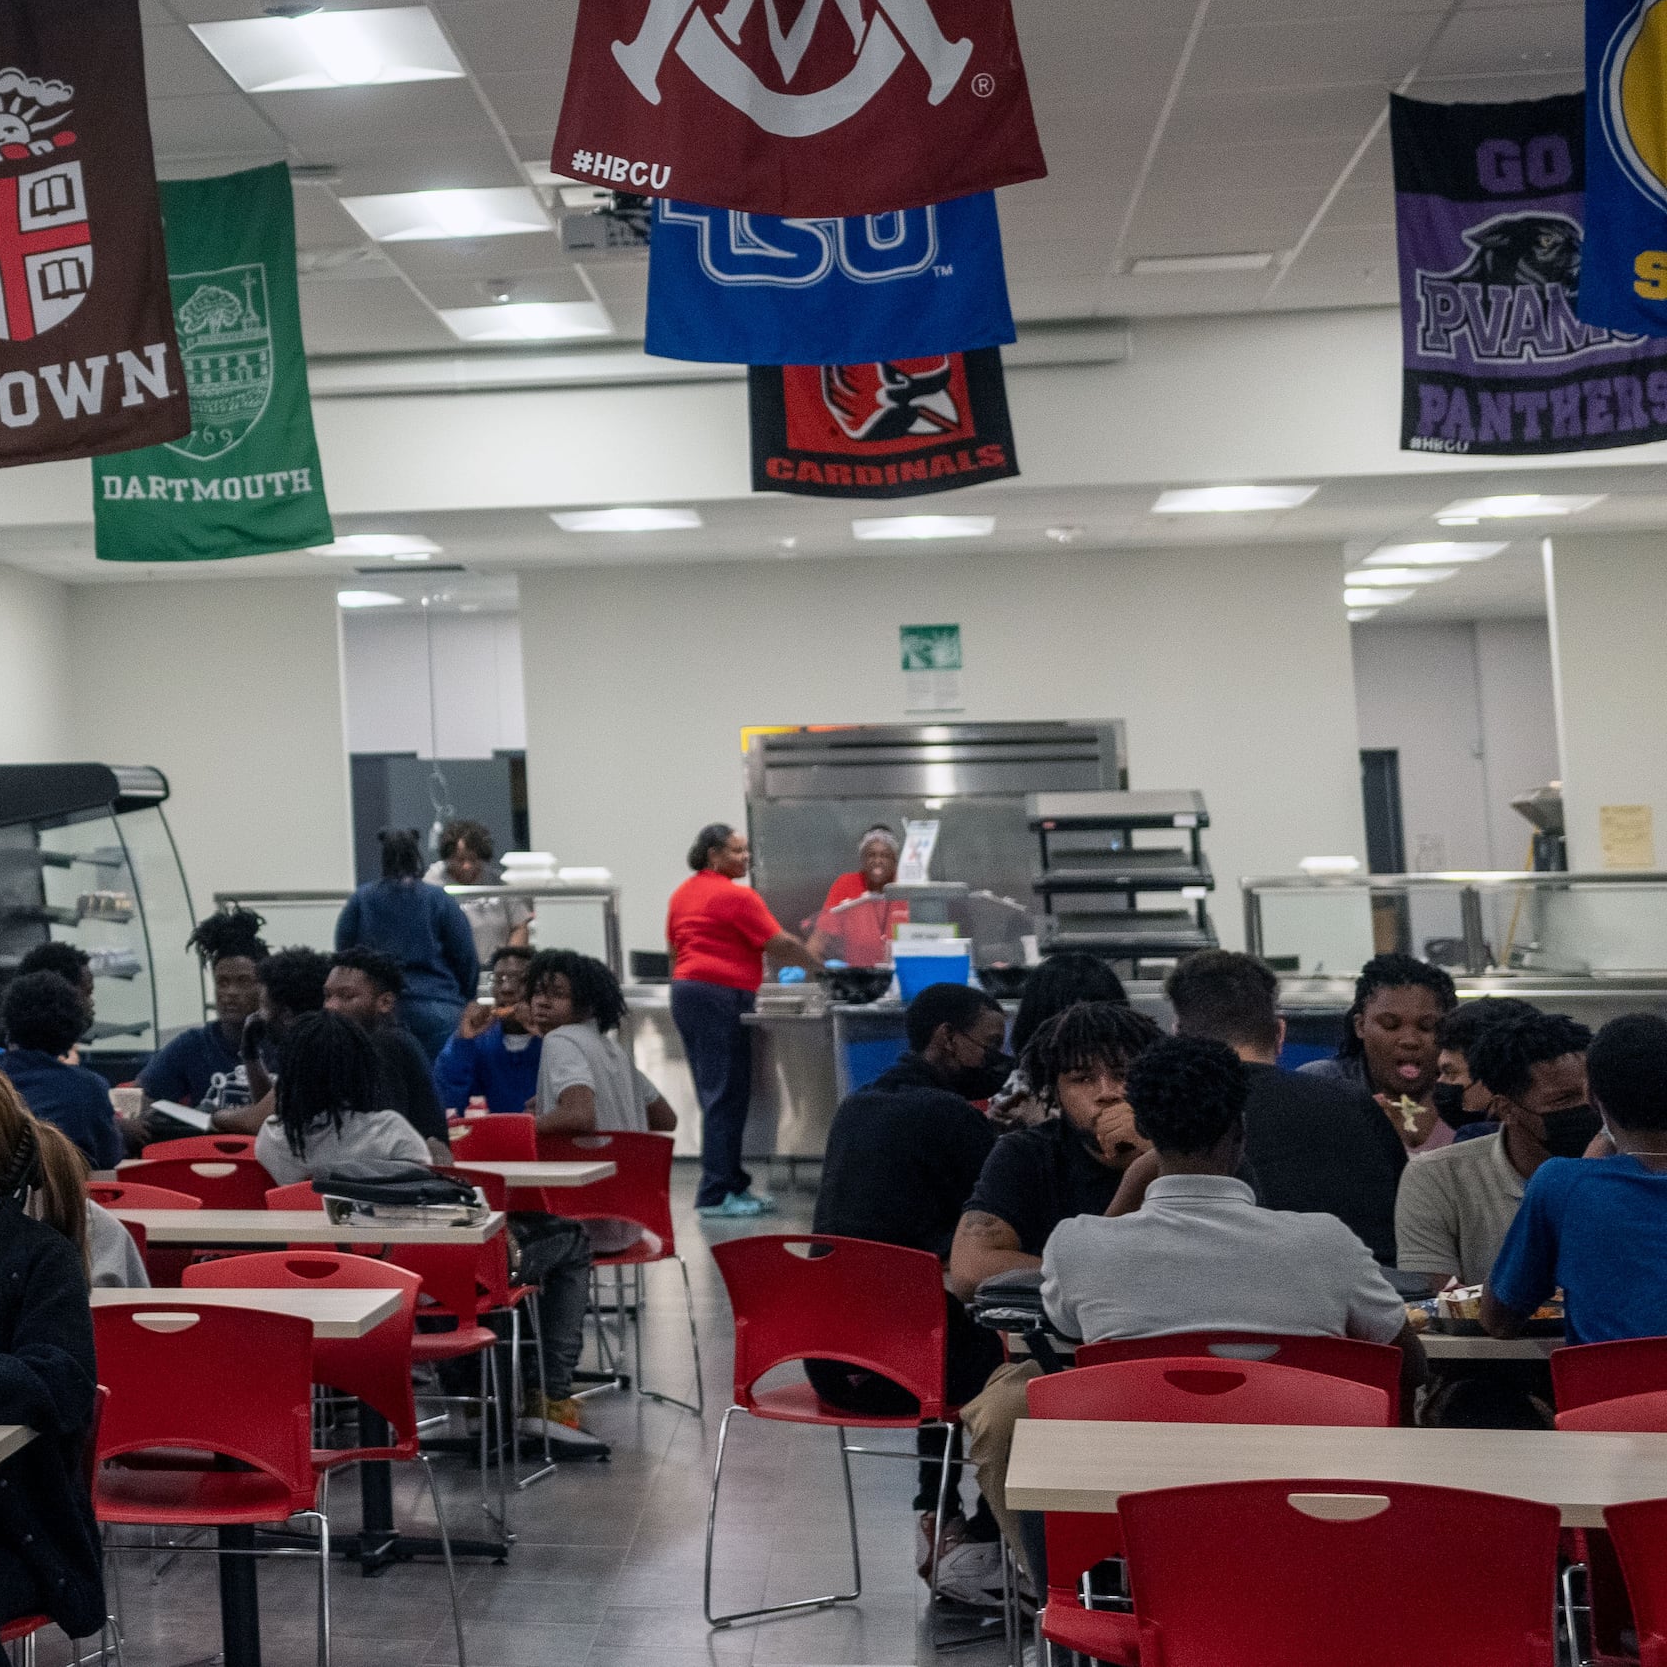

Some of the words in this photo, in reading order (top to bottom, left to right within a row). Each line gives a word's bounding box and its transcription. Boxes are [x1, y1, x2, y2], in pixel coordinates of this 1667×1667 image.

[570, 148, 672, 190] #HBCU
[1475, 135, 1574, 194] GO
[1419, 369, 1667, 443] PANTHERS
[101, 467, 313, 503] DARTMOUTH
[765, 443, 1007, 487] CARDINALS
